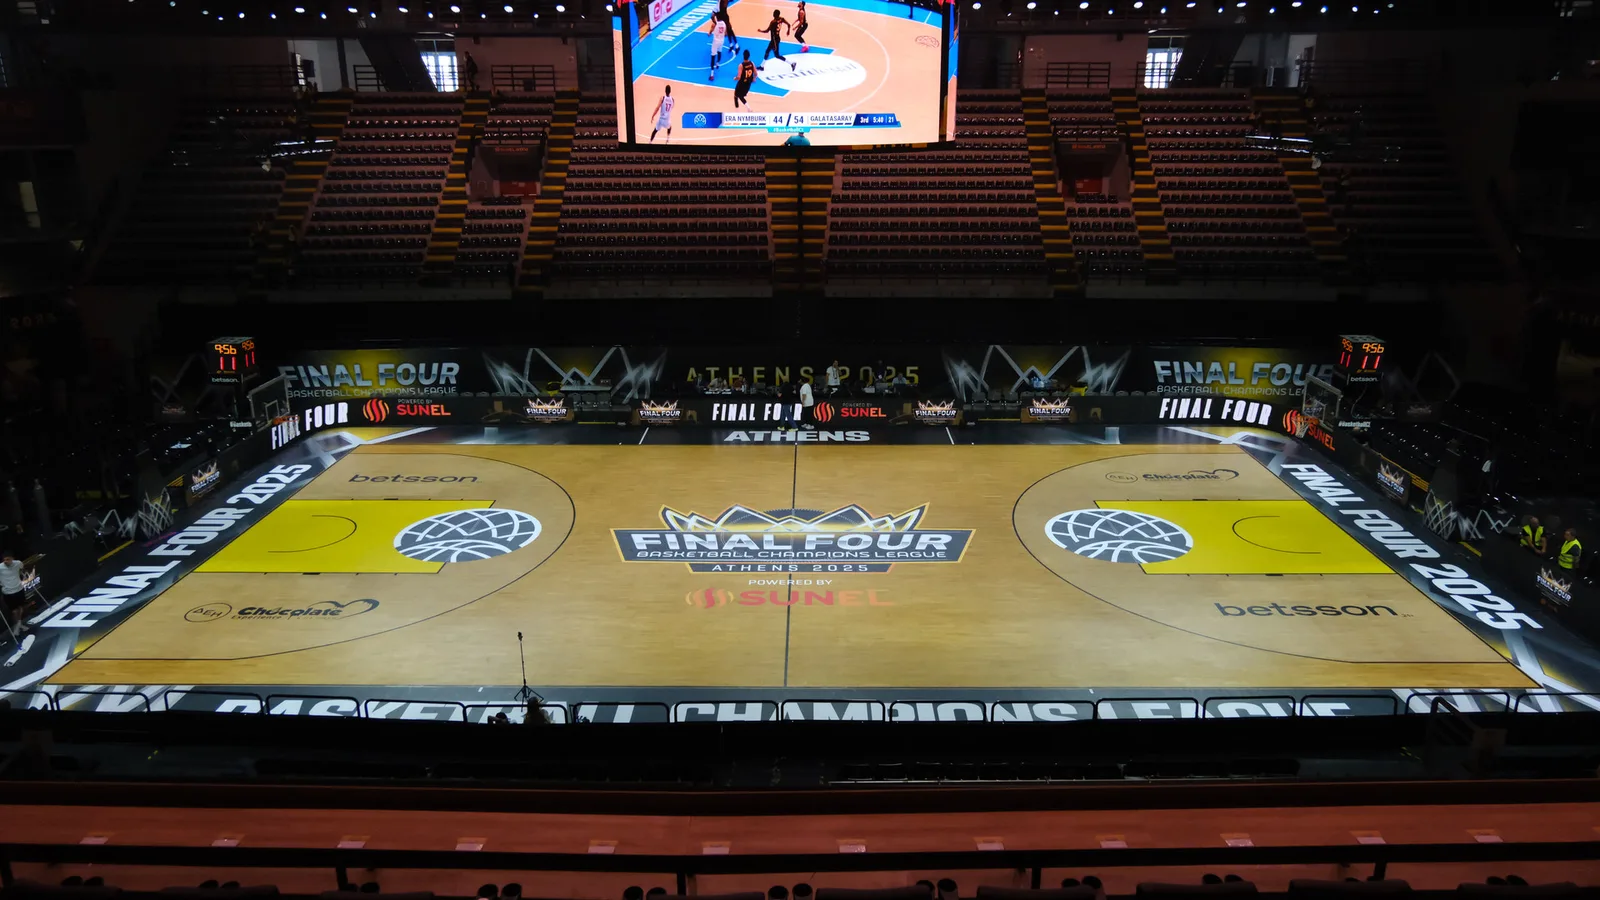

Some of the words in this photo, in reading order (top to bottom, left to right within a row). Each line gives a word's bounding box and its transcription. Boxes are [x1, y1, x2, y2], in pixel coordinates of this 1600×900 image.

[220, 356, 237, 370] 11
[1361, 355, 1380, 370] 11
[277, 364, 372, 388] FINAL
[378, 363, 460, 386] FOUR
[1154, 361, 1245, 384] FINAL
[287, 388, 351, 398] BASKETBALL
[354, 387, 415, 397] CHAMPIONS
[417, 386, 457, 396] LEAGUE
[1157, 385, 1220, 394] BASKETBALL
[1224, 385, 1286, 396] CHAMPIONS
[397, 404, 451, 416] SUNEL
[712, 403, 755, 421] FINAL
[841, 407, 887, 418] SUNEL
[1159, 398, 1213, 419] FINAL
[1221, 399, 1273, 426] FOUR
[272, 414, 300, 450] FINAL
[305, 402, 349, 432] FOUR
[723, 430, 871, 442] ATHENS
[1308, 423, 1336, 451] SUNEL
[348, 474, 478, 483] betsson
[40, 560, 182, 628] FINAL
[147, 507, 255, 556] FOUR
[227, 464, 312, 504] 2025
[630, 533, 793, 550] FINAL
[804, 533, 953, 550] FOUR
[1280, 464, 1365, 507] FINAL
[1338, 509, 1441, 559] FOUR
[1408, 563, 1544, 630] 2025
[712, 564, 798, 572] ATHENS
[812, 564, 869, 572] 2025
[739, 589, 894, 606] SUNEL
[237, 605, 343, 617] Chocolate
[1214, 602, 1399, 617] betsson
